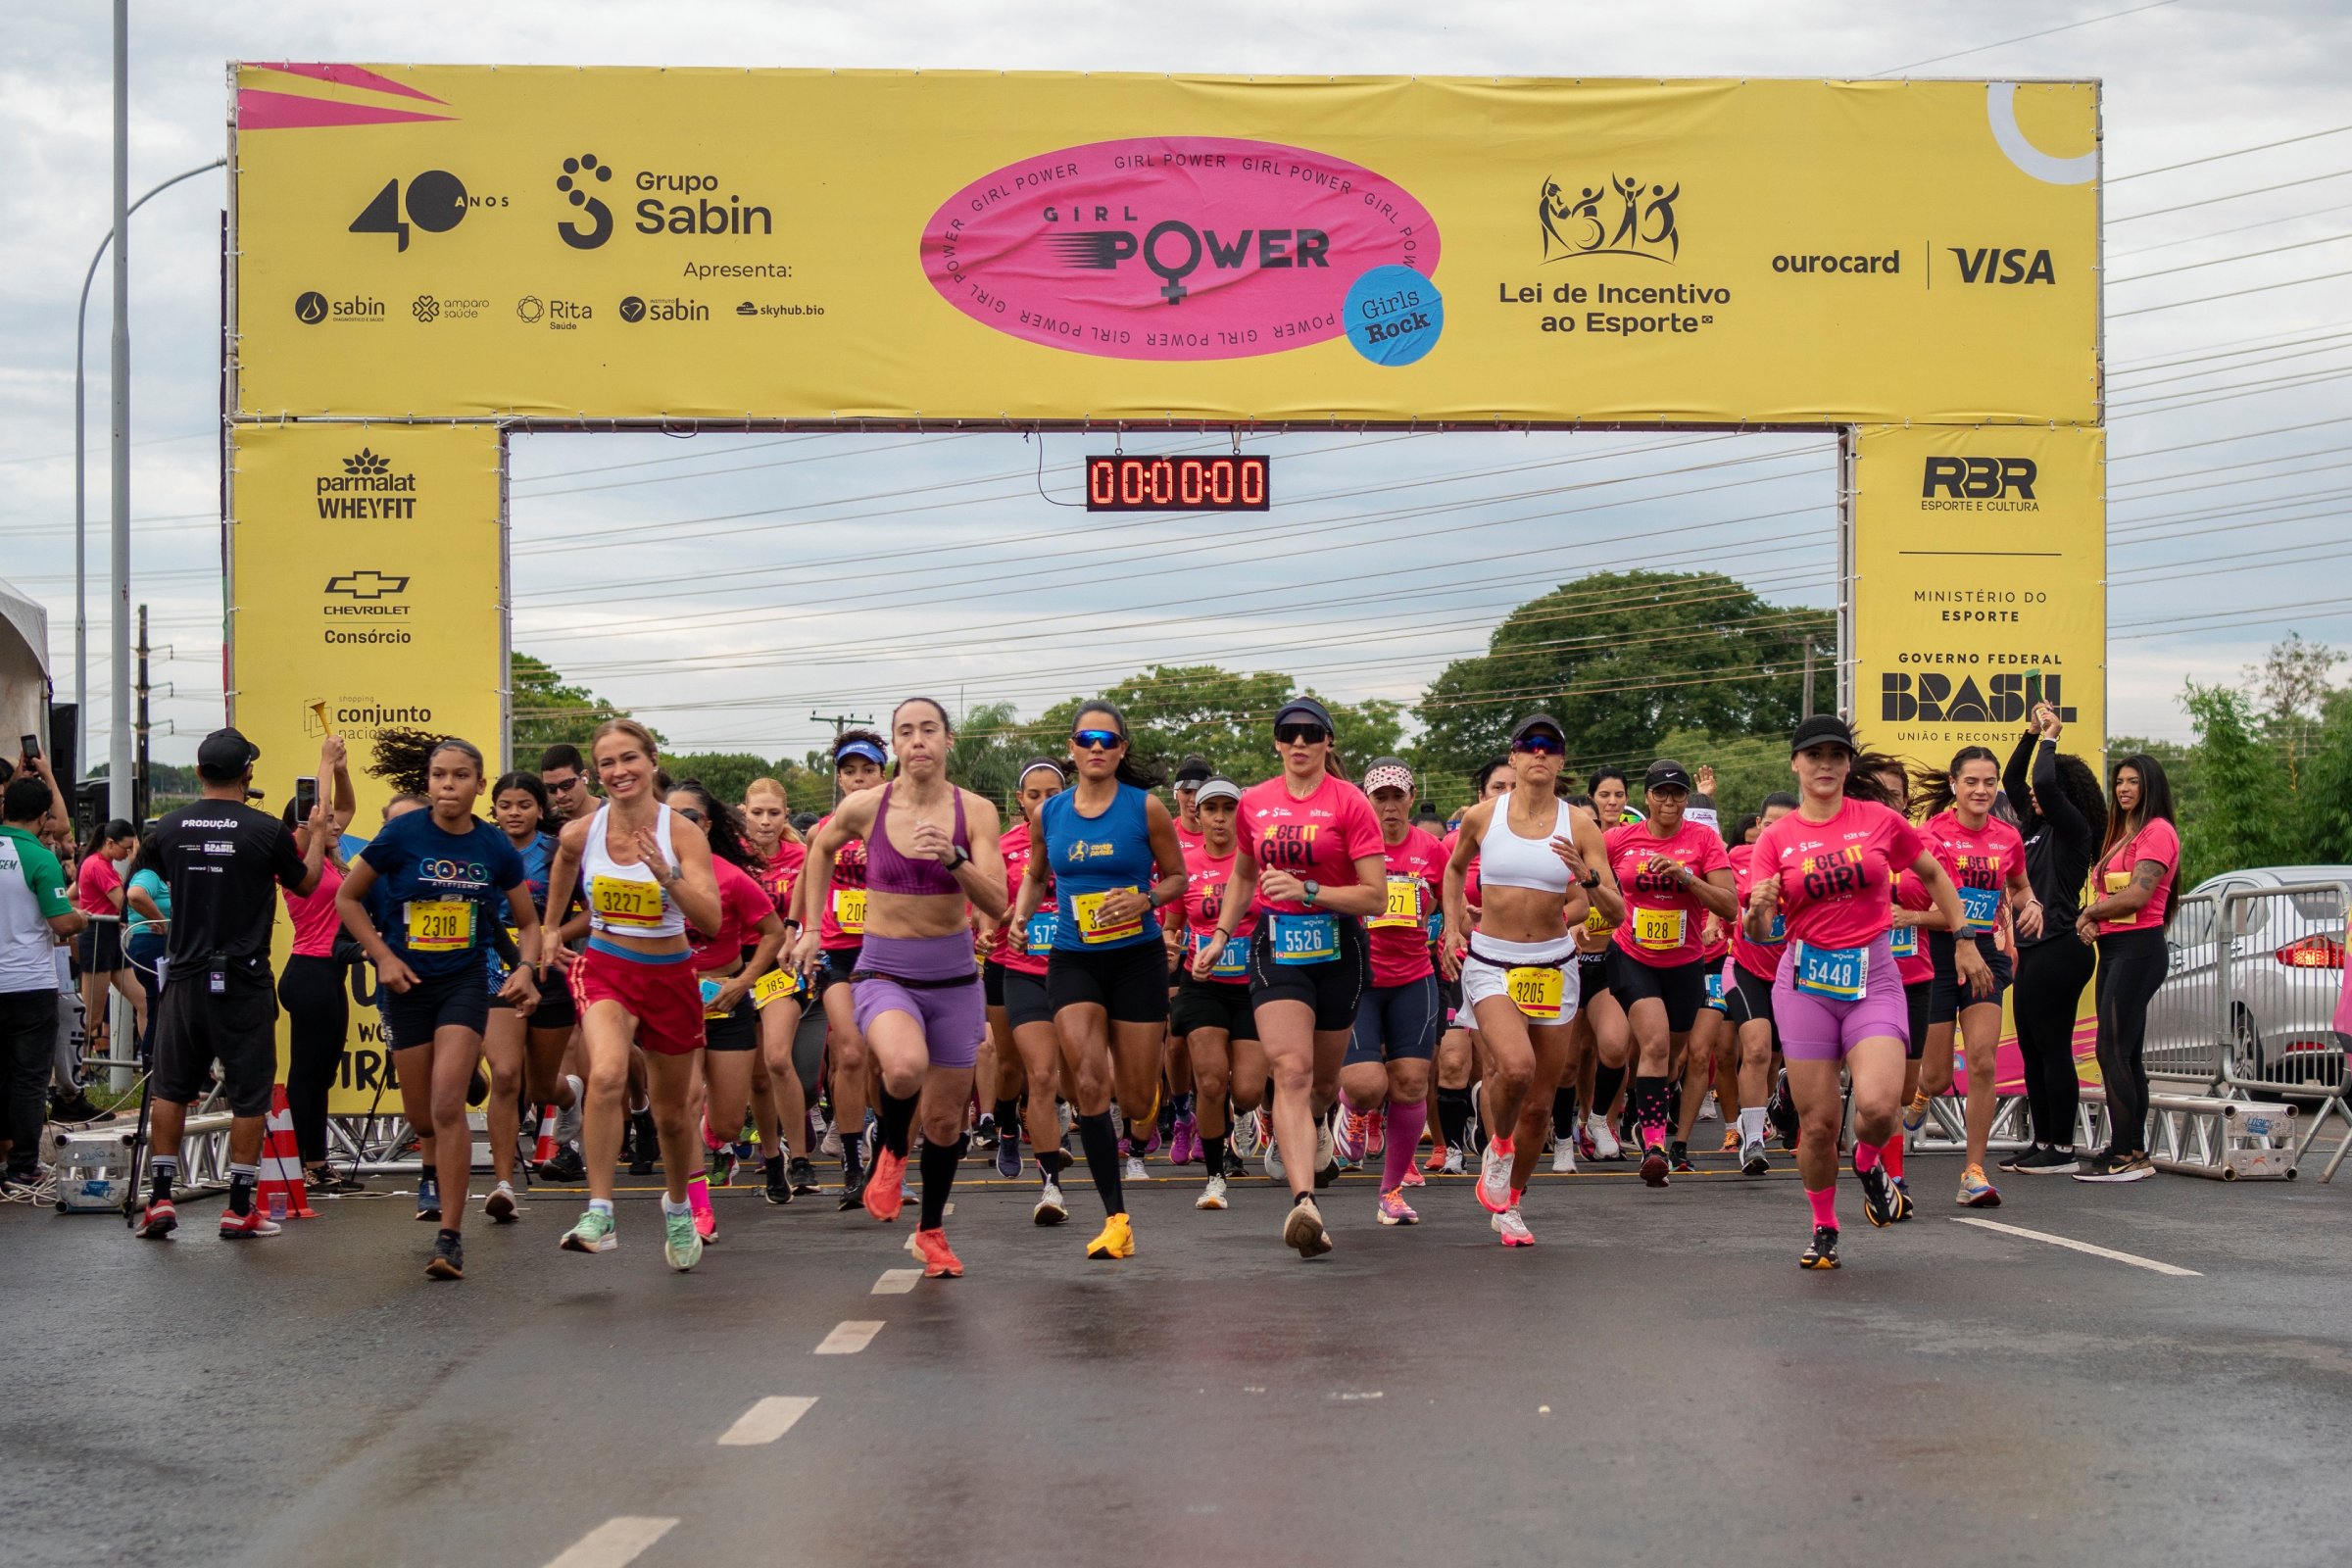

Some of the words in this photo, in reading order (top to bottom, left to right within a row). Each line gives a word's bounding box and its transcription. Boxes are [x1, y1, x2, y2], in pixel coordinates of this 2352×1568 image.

[1115, 156, 1154, 169] GIRL
[1164, 154, 1225, 167] POWER
[636, 172, 717, 194] Grupo
[1243, 158, 1280, 174] GIRL
[1291, 166, 1350, 194] POWER
[972, 185, 1009, 211] GIRL
[1015, 164, 1078, 189] POWER
[349, 171, 467, 253] 40
[455, 196, 509, 208] ANOS
[636, 194, 772, 235] Sabin
[1044, 207, 1137, 221] GIRL
[1365, 193, 1397, 223] GIRL
[1400, 227, 1416, 269] POW
[943, 219, 966, 284] POWER
[684, 263, 791, 280] Apresenta:
[1037, 220, 1330, 305] POWER
[1773, 250, 1899, 273] ourocard
[1948, 248, 2055, 284] VISA
[971, 284, 1005, 313] GIRL
[1500, 283, 1542, 303] Lei
[1553, 283, 1587, 303] de
[1599, 284, 1730, 304] Incentivo
[334, 296, 384, 316] sabin
[444, 299, 489, 310] amparo
[444, 309, 478, 318] saúde
[550, 300, 592, 319] Rita
[650, 298, 710, 321] sabin
[760, 305, 825, 318] skyhub.bio
[1362, 291, 1420, 319] Girls
[550, 321, 577, 330] Saúde
[1020, 311, 1081, 336] POWER
[1273, 314, 1334, 337] POWER
[1365, 312, 1431, 344] Rock
[1542, 317, 1575, 331] ao
[1588, 313, 1697, 336] Esporte
[1092, 327, 1130, 343] GIRL
[1148, 333, 1208, 346] POWER
[1218, 330, 1257, 344] GIRL
[318, 473, 416, 495] parmalat
[1092, 461, 1263, 504] 00:00:00
[1923, 457, 2036, 499] RBR
[318, 498, 416, 518] WHEYFIT
[1921, 501, 1973, 512] ESPORTE
[1976, 501, 1984, 512] E
[1986, 501, 2039, 512] CULTURA
[1914, 588, 2016, 604] MINISTÉRIO
[2024, 592, 2047, 604] DO
[323, 606, 411, 615] CHEVROLET
[1941, 611, 2019, 622] ESPORTE
[324, 629, 412, 644] Consórcio
[1898, 653, 1980, 664] GOVERNO
[1987, 654, 2062, 665] FEDERAL
[337, 704, 431, 726] conjunto
[338, 726, 378, 740] nacio
[1897, 730, 1938, 742] UNIÃO
[1944, 732, 1951, 742] E
[181, 818, 238, 830] PRODUÇÃO
[1260, 839, 1321, 867] GIRL
[1803, 862, 1873, 900] GIRL
[603, 891, 642, 912] 3227
[1389, 895, 1404, 913] 27
[1965, 900, 1987, 919] 752
[422, 914, 457, 937] 2318
[1646, 921, 1669, 939] 828
[1285, 929, 1322, 952] 5526
[1808, 957, 1852, 987] 5448
[766, 976, 785, 994] 185
[1516, 982, 1545, 1004] 3205
